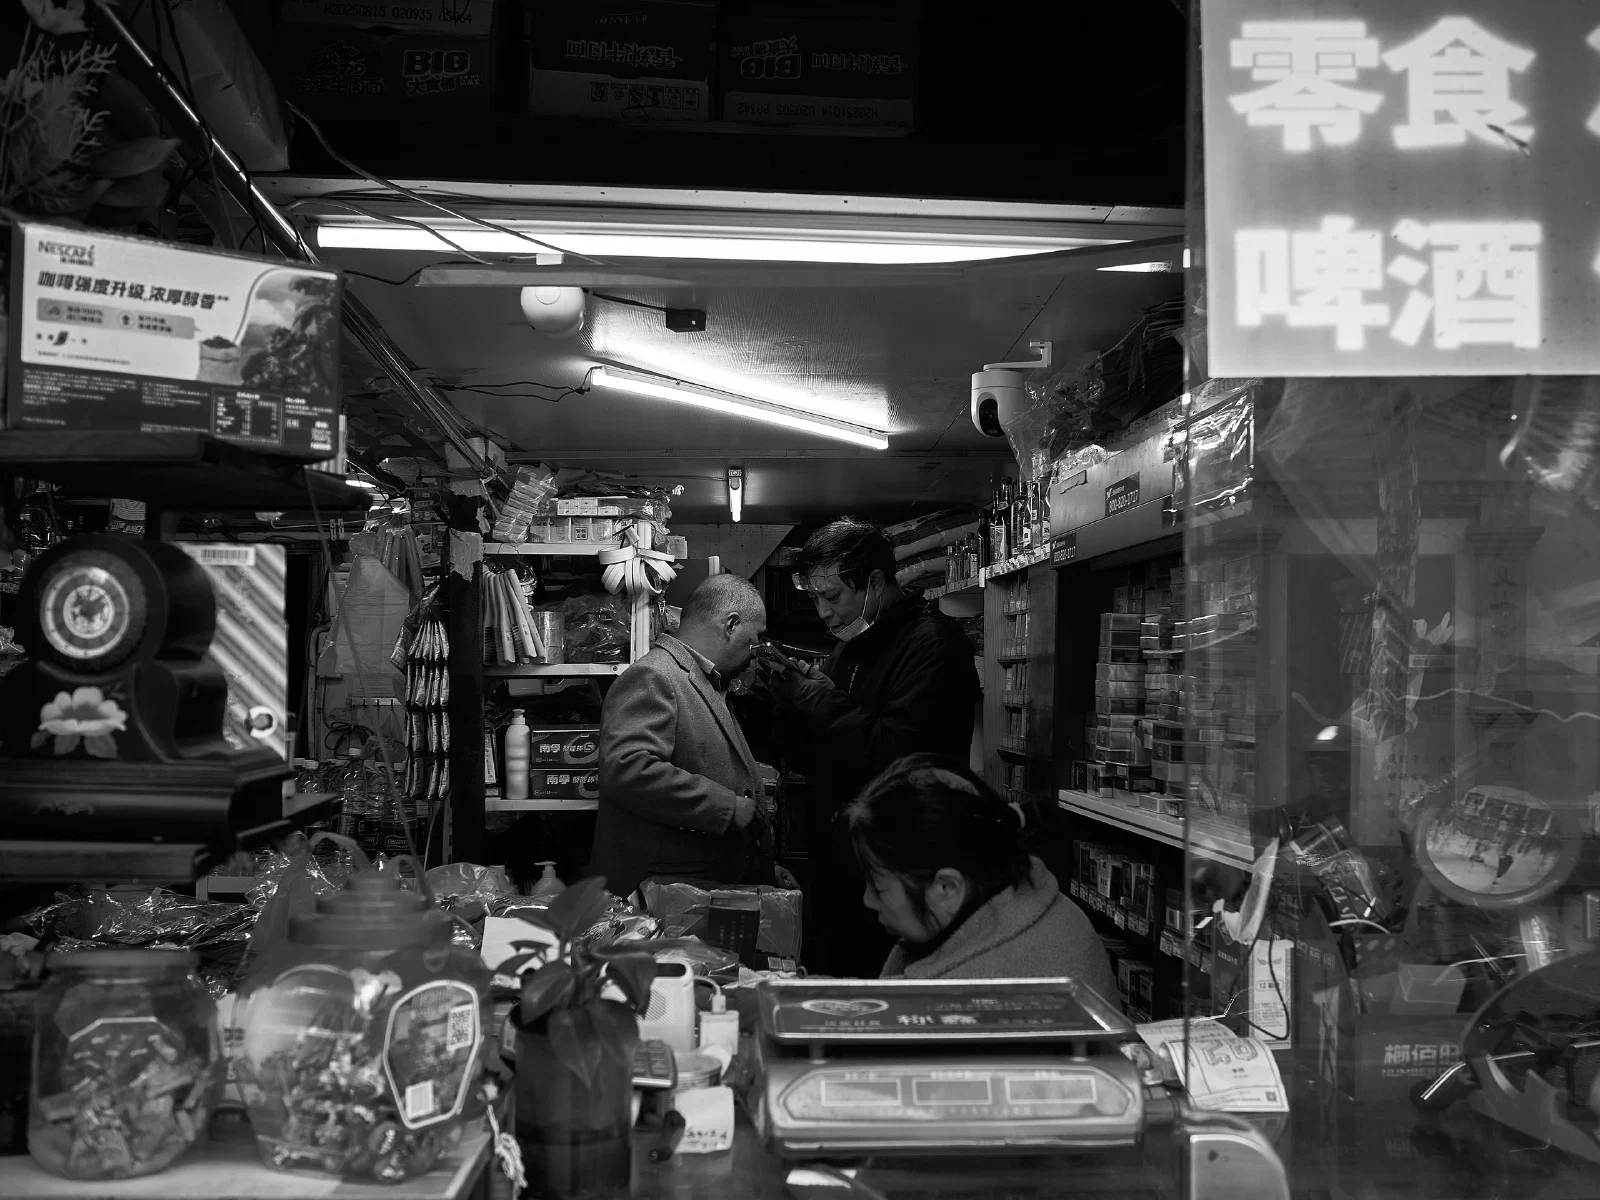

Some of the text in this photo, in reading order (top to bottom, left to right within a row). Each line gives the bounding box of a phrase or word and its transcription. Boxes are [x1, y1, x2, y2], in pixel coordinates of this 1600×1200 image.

[324, 3, 386, 18] H20250815
[392, 7, 433, 20] 020935
[403, 49, 472, 78] BIG
[741, 54, 802, 80] BIG
[1228, 15, 1536, 152] 零食
[1234, 214, 1542, 350] 啤酒
